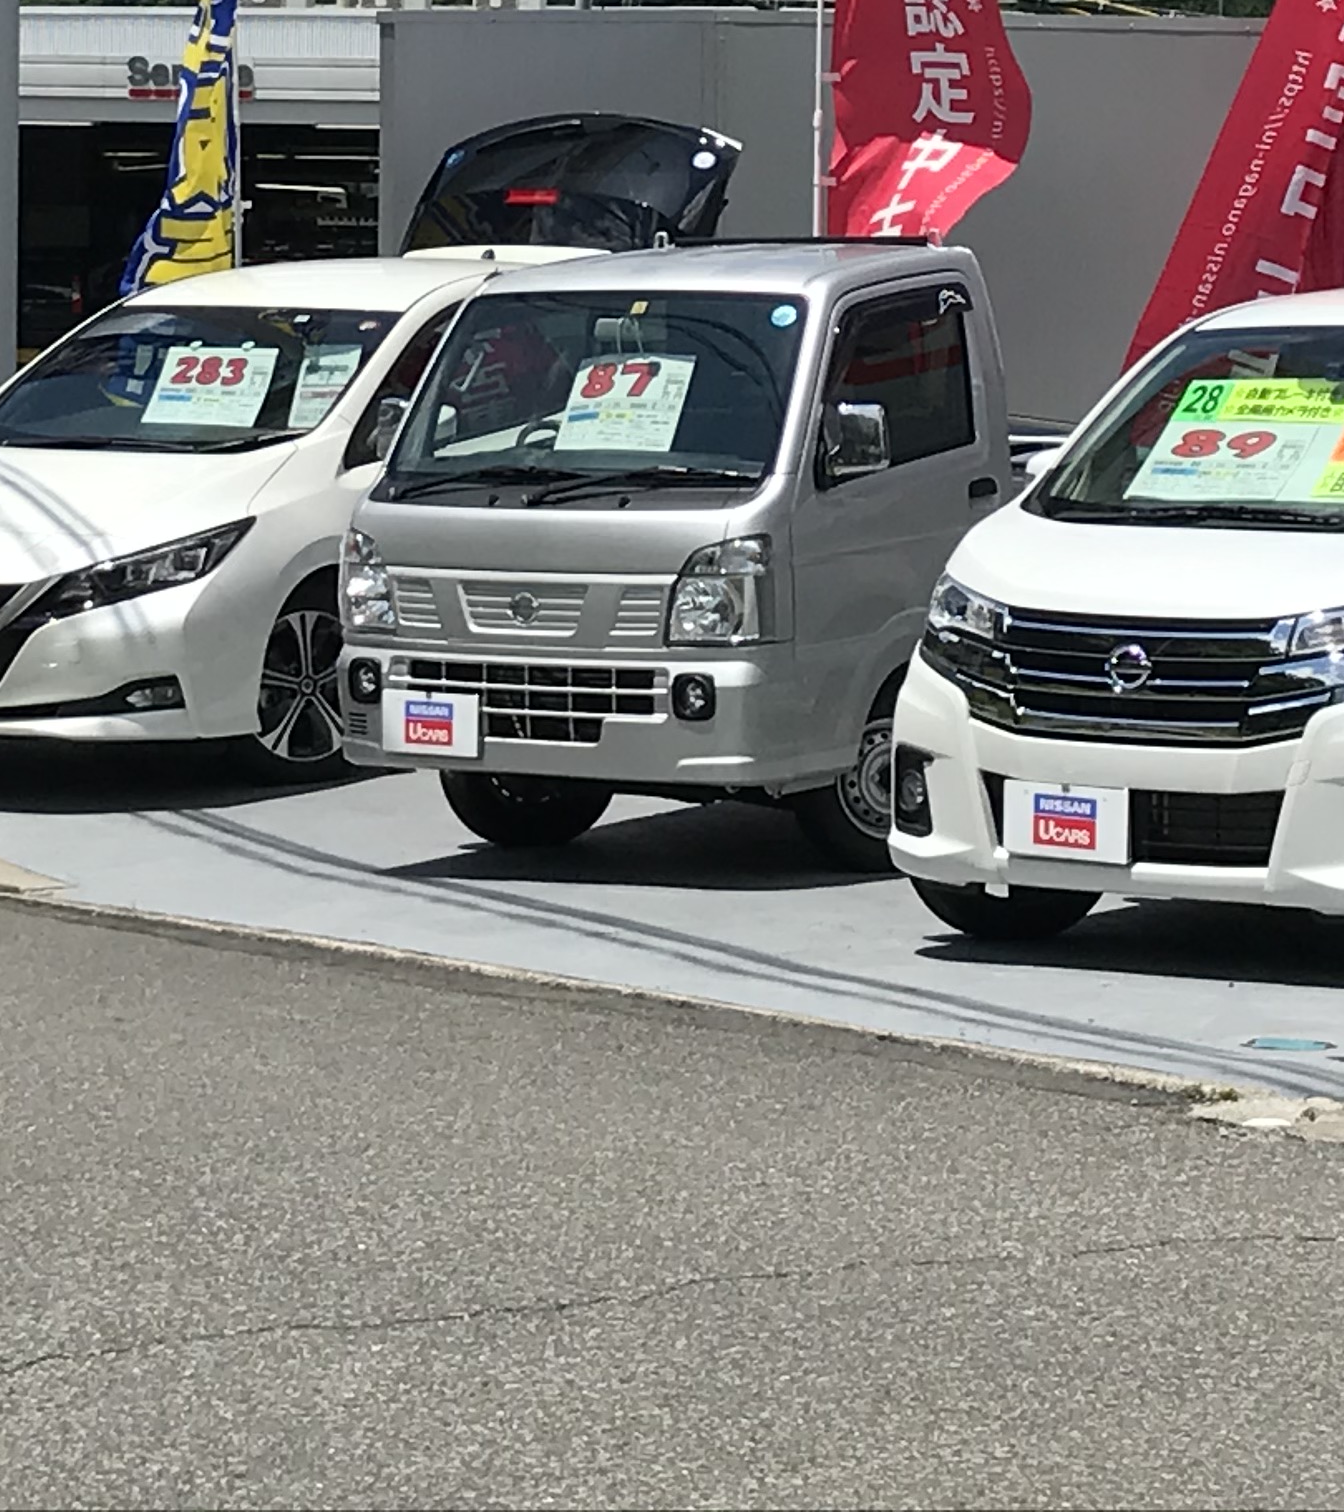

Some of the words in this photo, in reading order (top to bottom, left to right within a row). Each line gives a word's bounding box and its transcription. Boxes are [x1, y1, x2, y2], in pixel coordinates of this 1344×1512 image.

[170, 355, 249, 387] 283
[580, 361, 662, 399] 87
[1182, 384, 1224, 414] 28
[1170, 428, 1278, 460] 89
[1038, 797, 1092, 816] NISSAN
